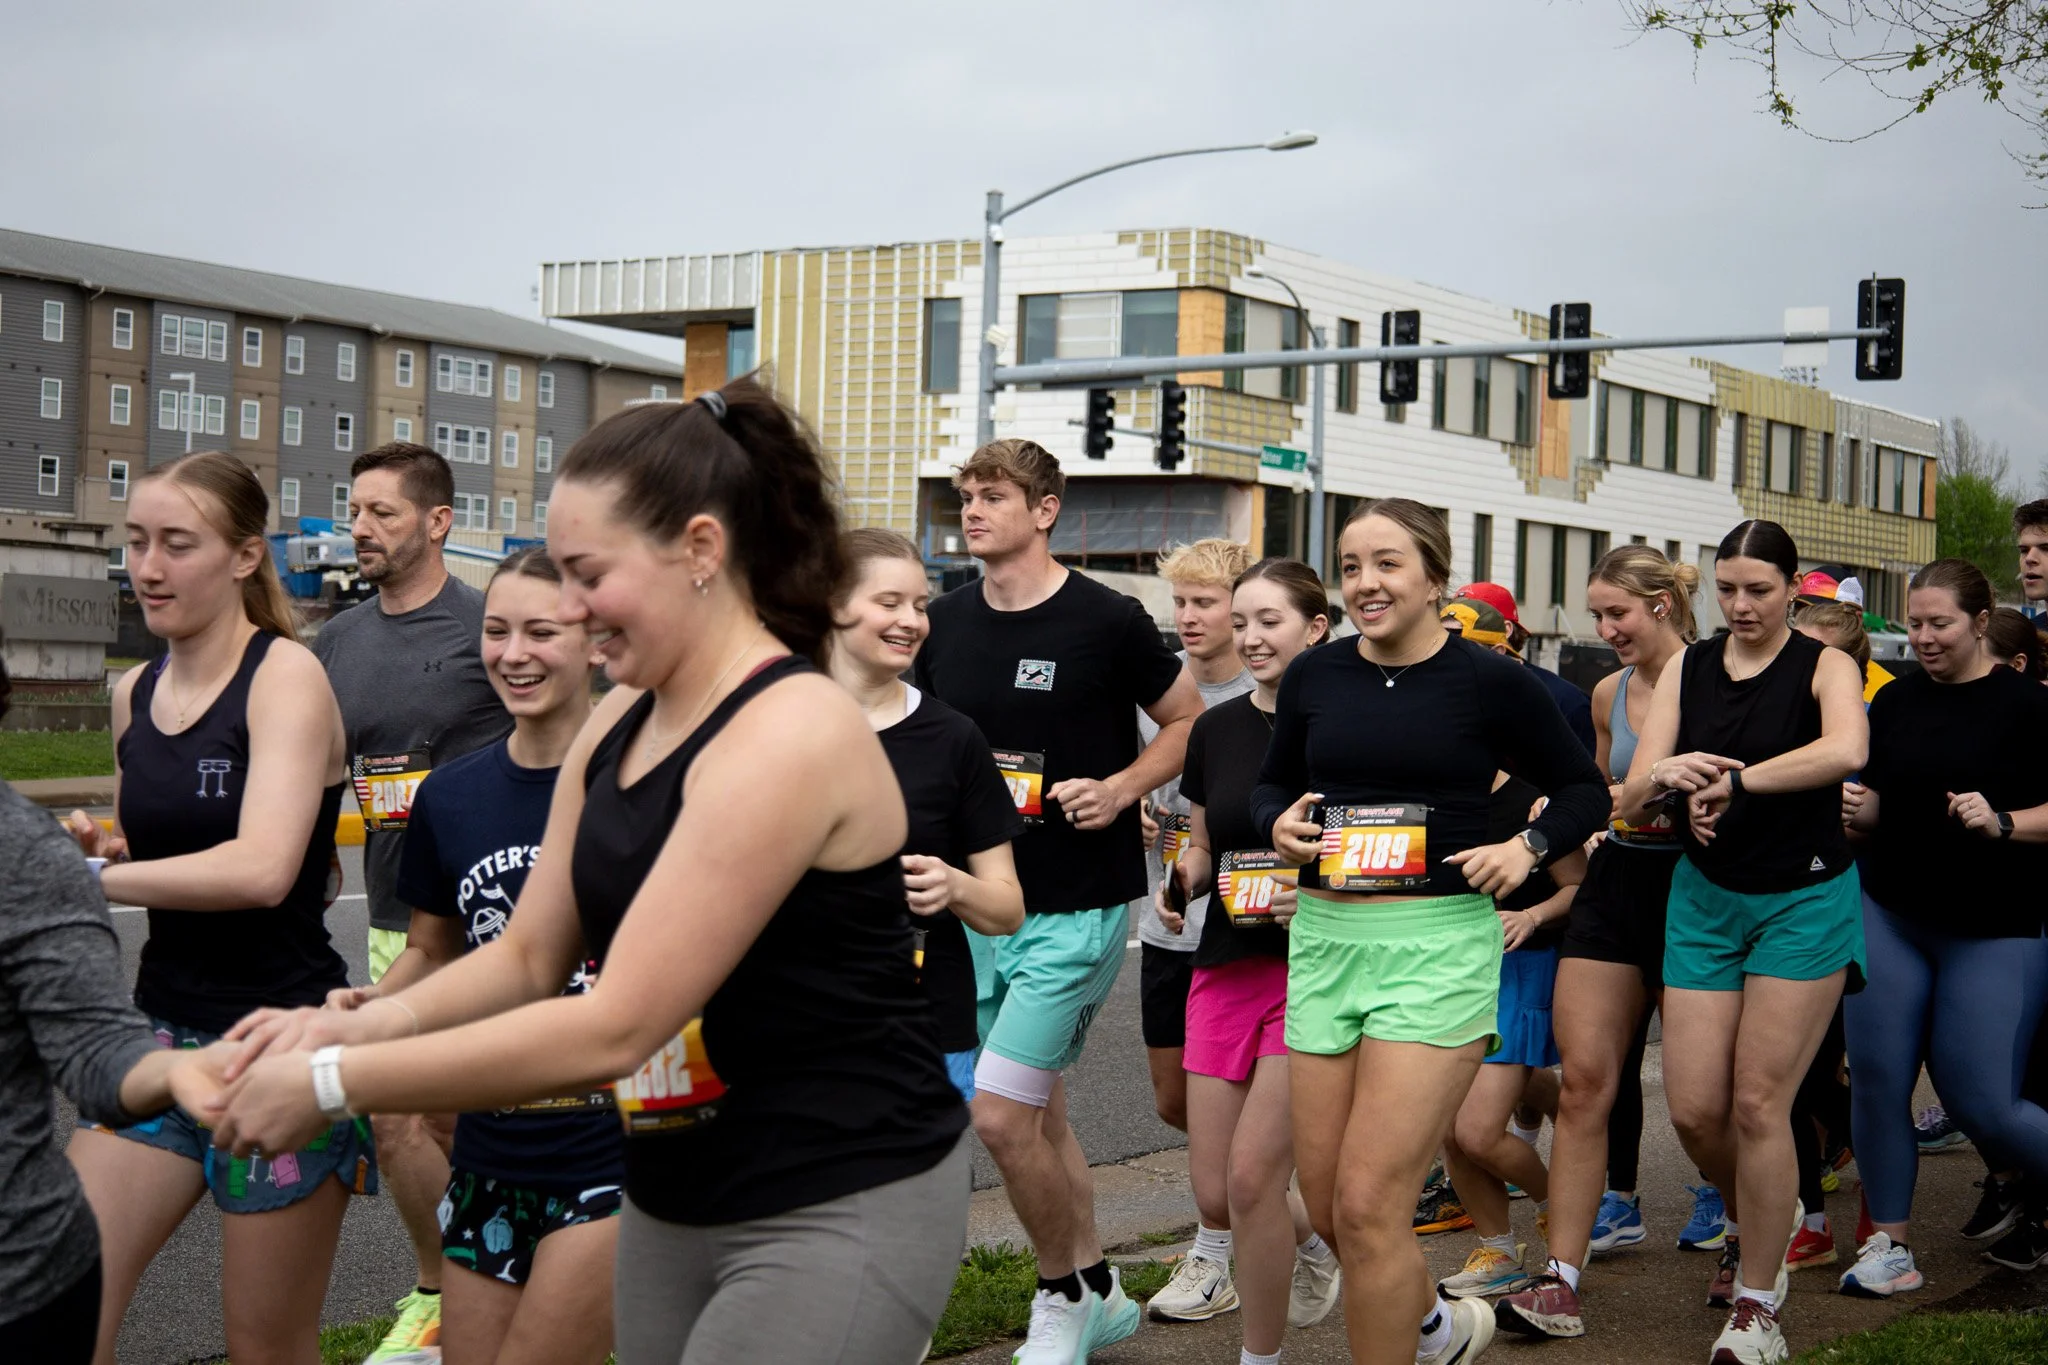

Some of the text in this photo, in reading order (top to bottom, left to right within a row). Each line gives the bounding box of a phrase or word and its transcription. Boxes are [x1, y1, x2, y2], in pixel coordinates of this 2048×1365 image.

[14, 586, 110, 627] Missouri
[1356, 807, 1405, 817] HEARTLAND
[1341, 832, 1410, 870] 2189
